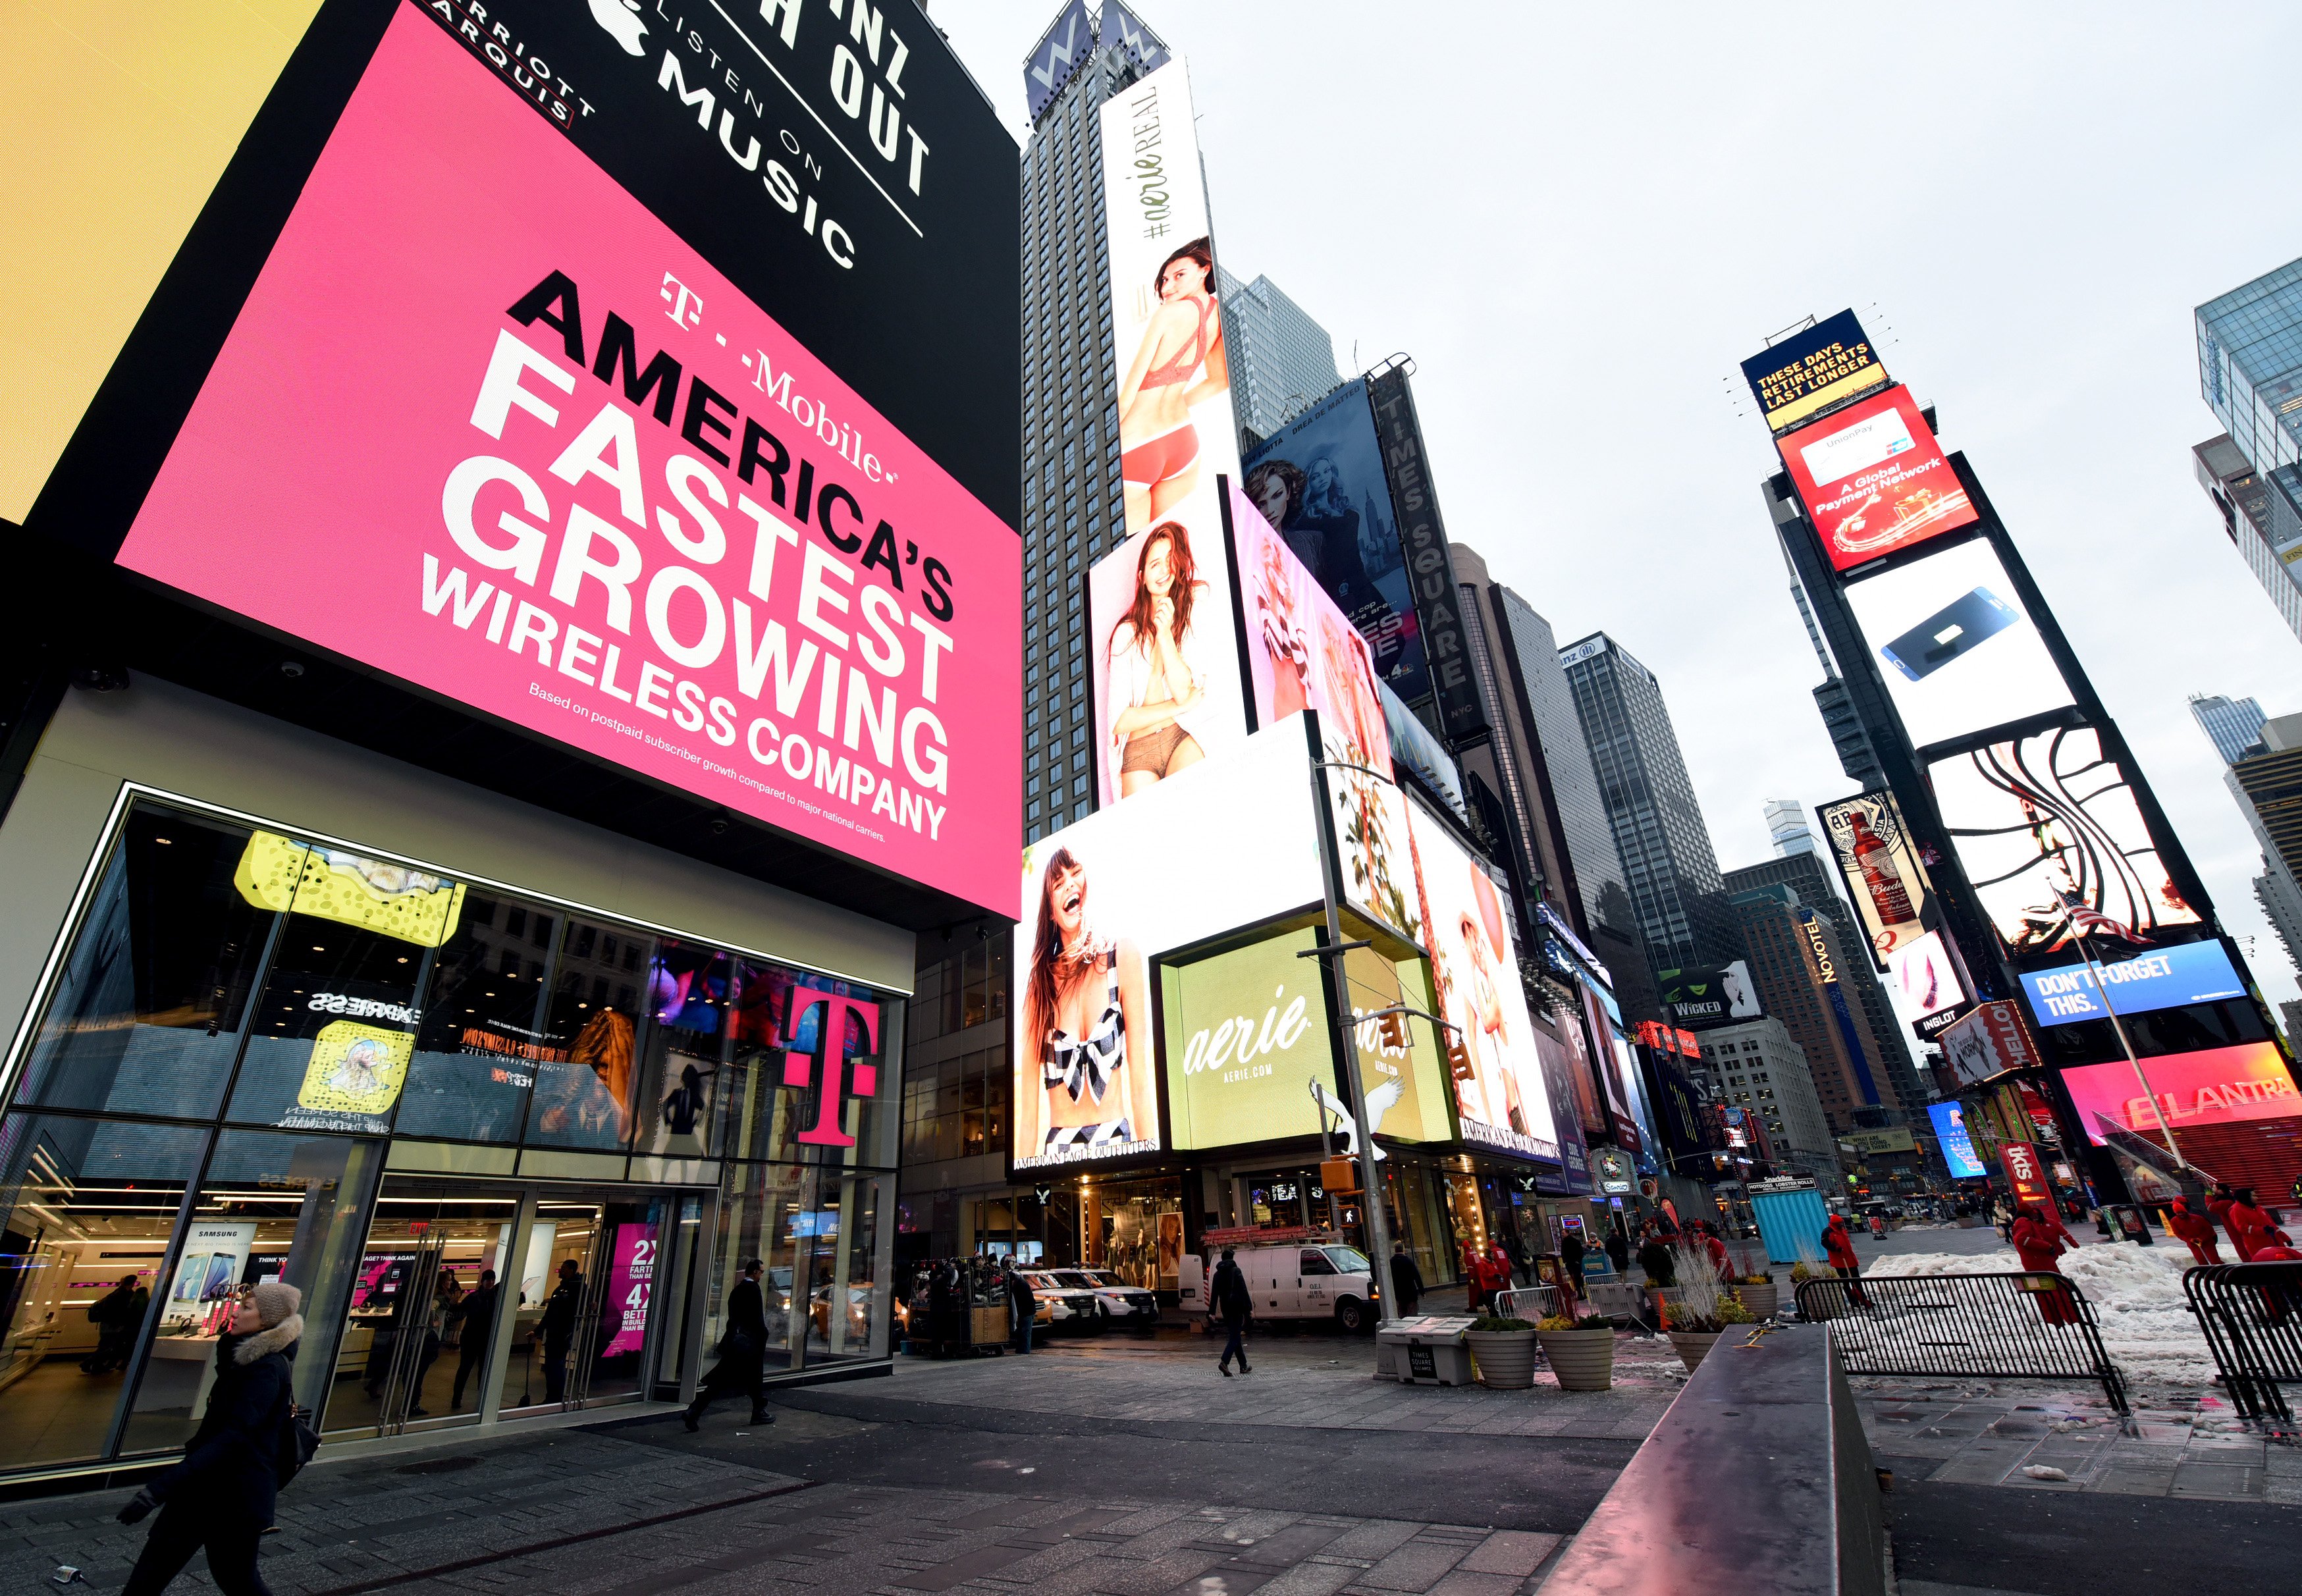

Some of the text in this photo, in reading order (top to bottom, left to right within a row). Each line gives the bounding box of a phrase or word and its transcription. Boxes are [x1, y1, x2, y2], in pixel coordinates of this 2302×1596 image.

[1031, 12, 1077, 91] W
[657, 1, 821, 181] LISTEN ON
[830, 44, 929, 196] OUT
[658, 49, 855, 269] MUSIC
[1757, 342, 1842, 388] THESE DAYS
[1761, 343, 1868, 400] RETIREMENTS
[1766, 355, 1869, 409] LAST LONGER
[1293, 386, 1360, 435] DREA DE MATTEO
[1827, 425, 1872, 448] UnionPay
[506, 269, 953, 622] AMERICA'S
[1258, 438, 1283, 458] LIOTTA
[1380, 394, 1423, 512] TIMES
[1816, 458, 1941, 515] Payment Network
[1841, 463, 1900, 495] A Global
[469, 327, 953, 704] FASTEST
[442, 455, 948, 795] GROWING
[1359, 601, 1376, 613] cop
[1412, 523, 1466, 689] SQUARE
[421, 552, 946, 841] WIRELESS COMPANY
[1451, 704, 1472, 718] NYC
[529, 682, 886, 842] Based on postpaid subscriber growth compared to major national carriers.
[1804, 916, 1837, 984] NOVOTEL
[2035, 955, 2172, 996] DON'T FORGET
[1923, 1011, 1956, 1031] INGLOT
[2043, 993, 2099, 1017] THIS.
[1990, 1004, 2029, 1065] HELLO!
[1223, 1063, 1272, 1083] AERIE.COM
[2126, 1077, 2293, 1129] ELANTRA
[1015, 1138, 1156, 1170] AMERICAN EAGLE OUTFITTERS
[2007, 1146, 2033, 1180] tkts
[1605, 1183, 1628, 1191] Sanrio
[410, 1222, 429, 1235] EXIT
